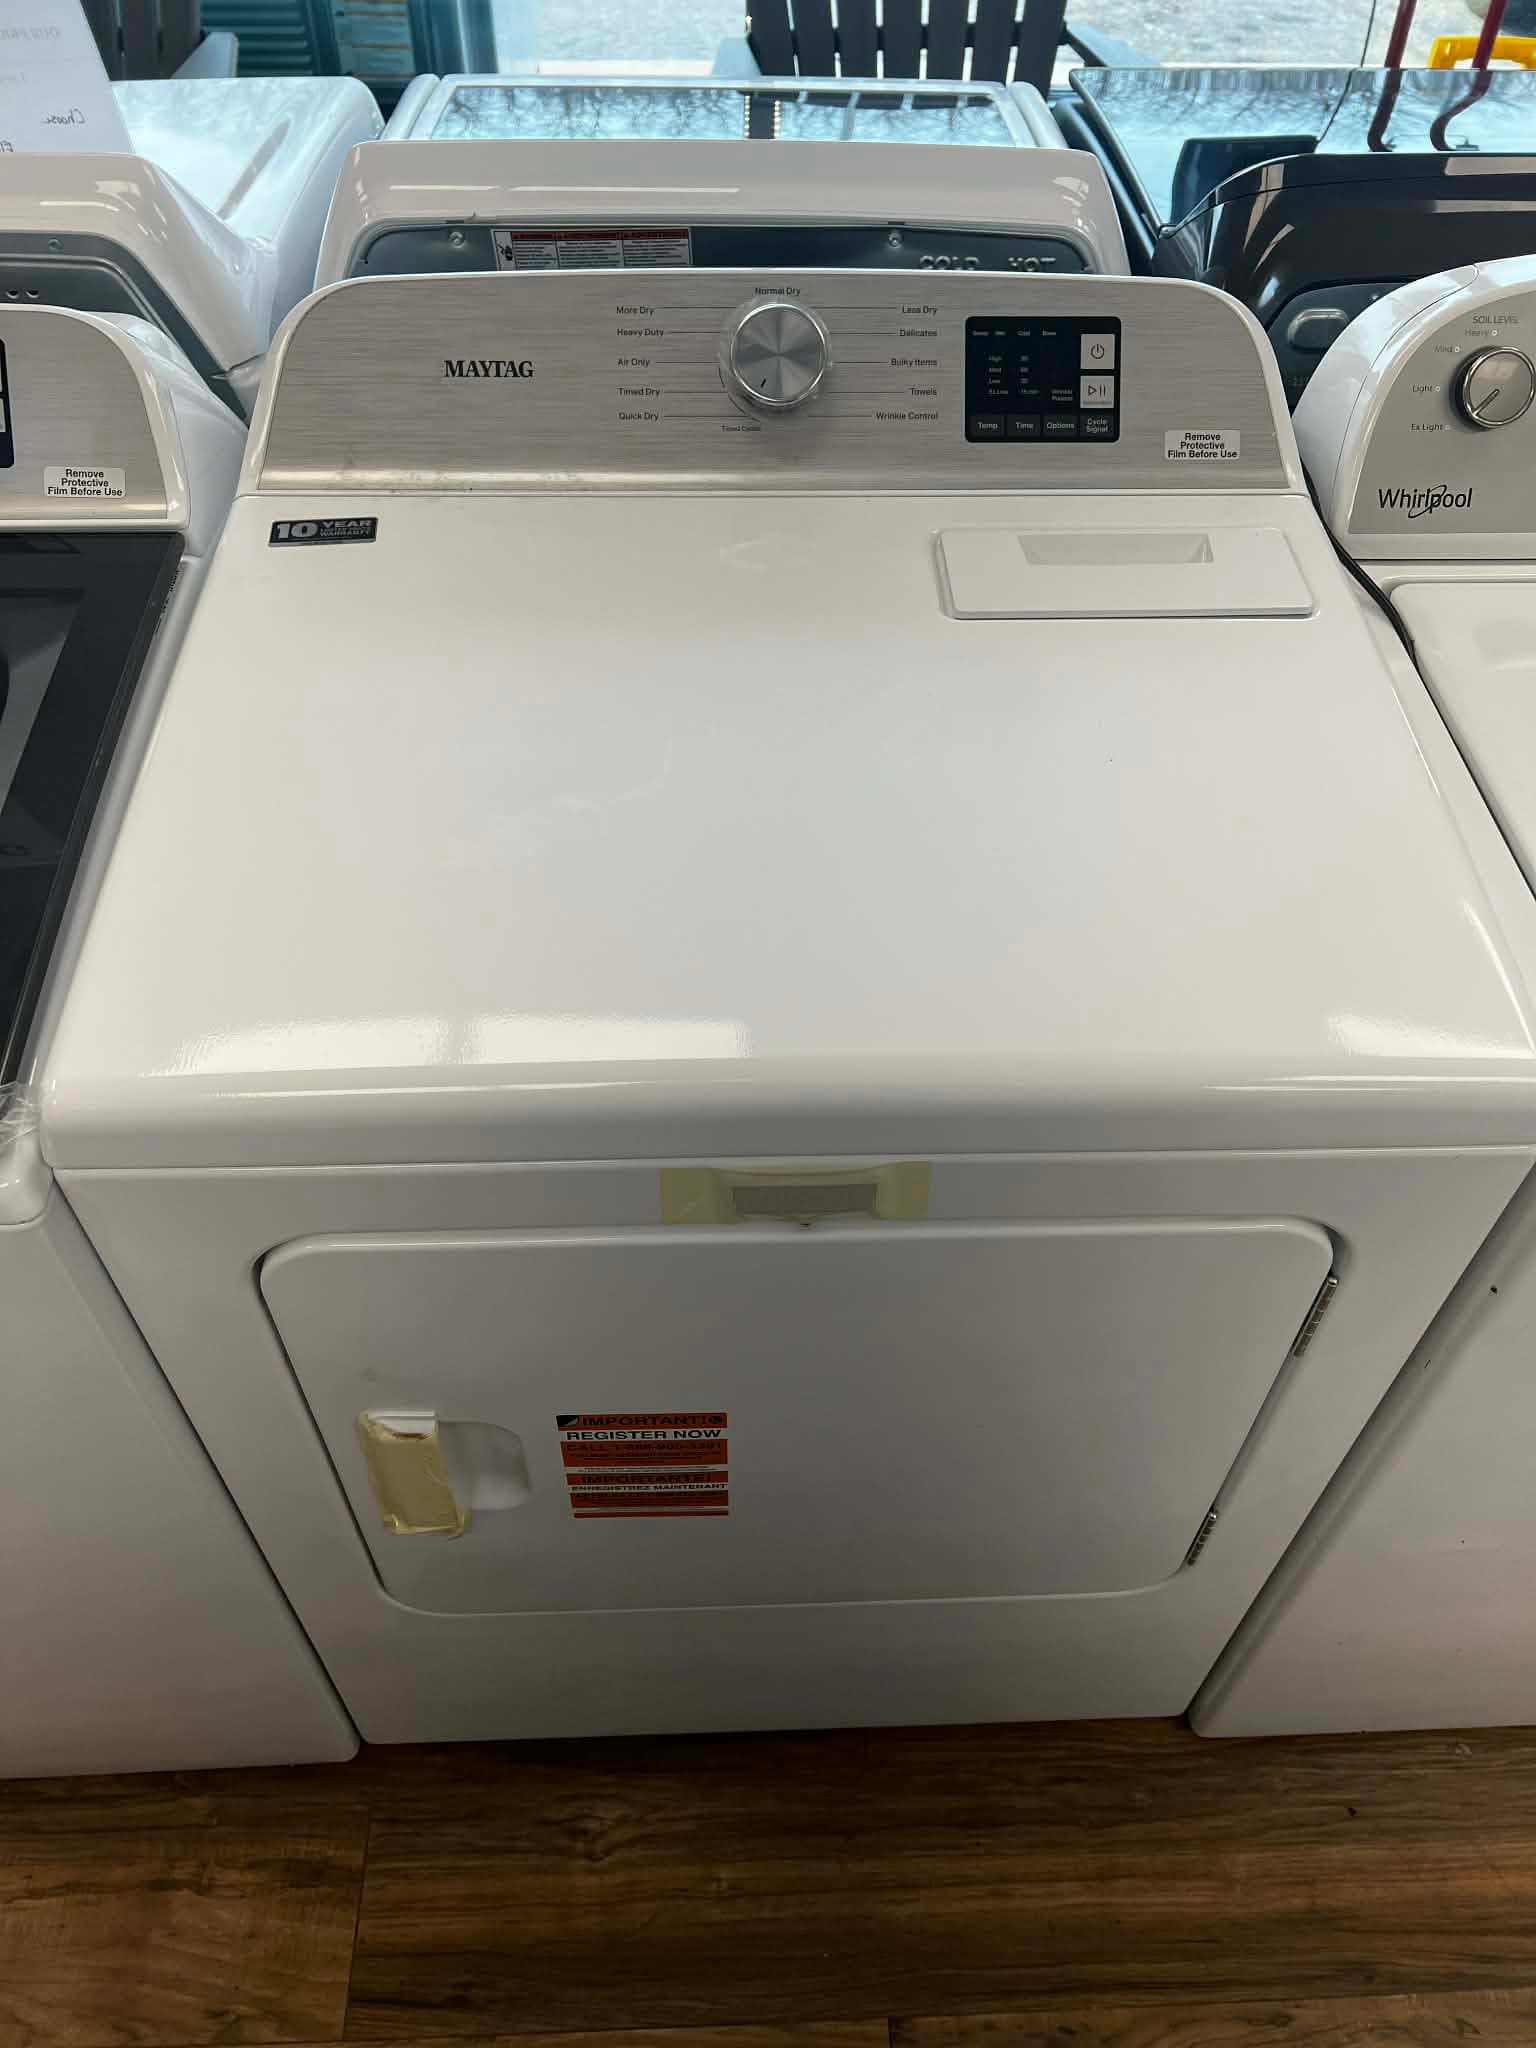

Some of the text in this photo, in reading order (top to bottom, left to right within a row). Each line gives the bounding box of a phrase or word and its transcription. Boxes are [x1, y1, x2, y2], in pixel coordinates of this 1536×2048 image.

[1008, 256, 1056, 272] HOT
[754, 287, 801, 297] Normal Dry
[616, 306, 655, 316] More Dry
[902, 305, 938, 316] Less Dry
[1472, 315, 1519, 325] SOIL LEVEL
[616, 328, 664, 338] Heavy Duty
[900, 329, 938, 337] Delicates
[617, 358, 650, 368] Air Only
[890, 358, 938, 368] Bulky Items
[443, 360, 535, 378] MAYTAG
[617, 387, 660, 397] Timed Dry
[910, 387, 937, 396] Towels
[1412, 384, 1433, 395] Light
[618, 411, 659, 422] Quick Dry
[876, 411, 938, 421] Wrinkle Control
[977, 422, 998, 431] Temp
[1015, 422, 1034, 430] Time
[1046, 422, 1075, 431] Options
[1411, 423, 1443, 433] Ex Light
[1184, 432, 1221, 441] Remove
[1180, 441, 1225, 449] Protective
[1168, 449, 1238, 458] Film Before Use
[65, 468, 105, 478] Remove
[61, 477, 109, 487] Protective
[47, 486, 123, 496] Film Before Use
[1378, 486, 1473, 515] Whirlpool
[277, 522, 318, 539] 10
[321, 519, 372, 529] YEAR
[582, 1415, 704, 1427] IMPORTANT!
[566, 1429, 721, 1441] REGISTER NOW
